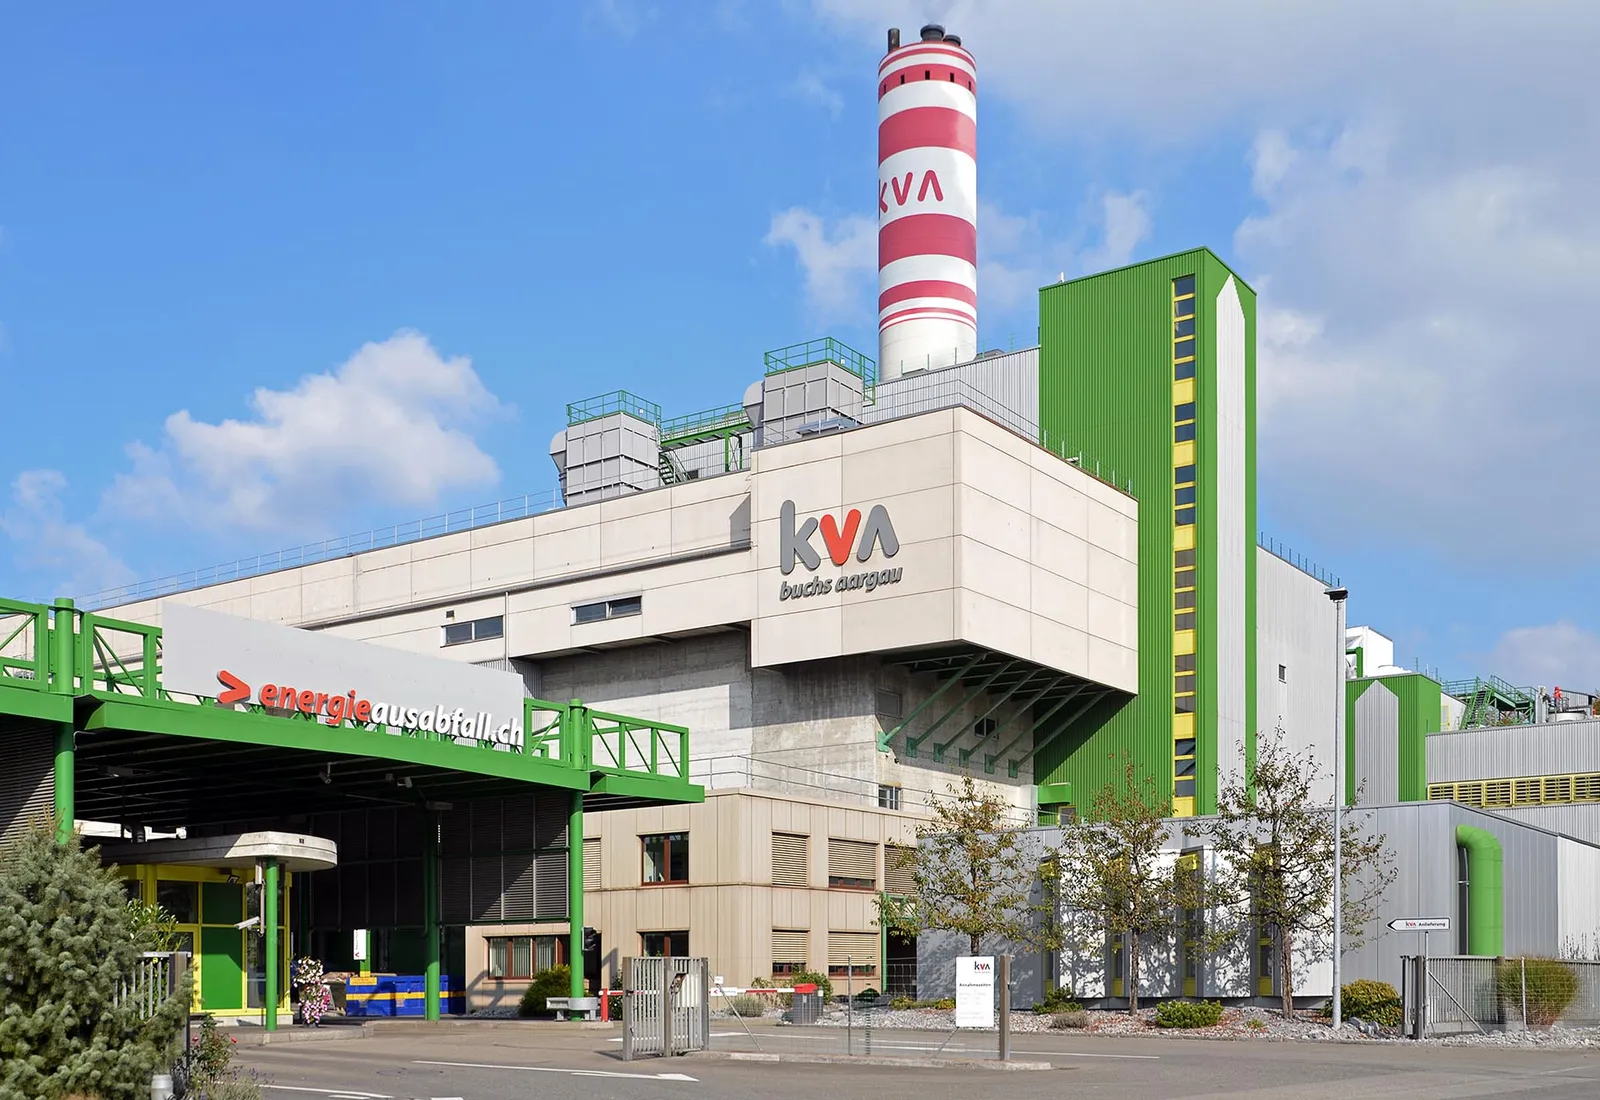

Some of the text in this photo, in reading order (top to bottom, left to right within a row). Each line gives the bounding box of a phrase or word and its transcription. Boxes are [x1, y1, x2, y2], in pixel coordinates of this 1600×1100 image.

[779, 567, 904, 602] buchs aargau
[259, 683, 524, 747] energieausabfall.ch
